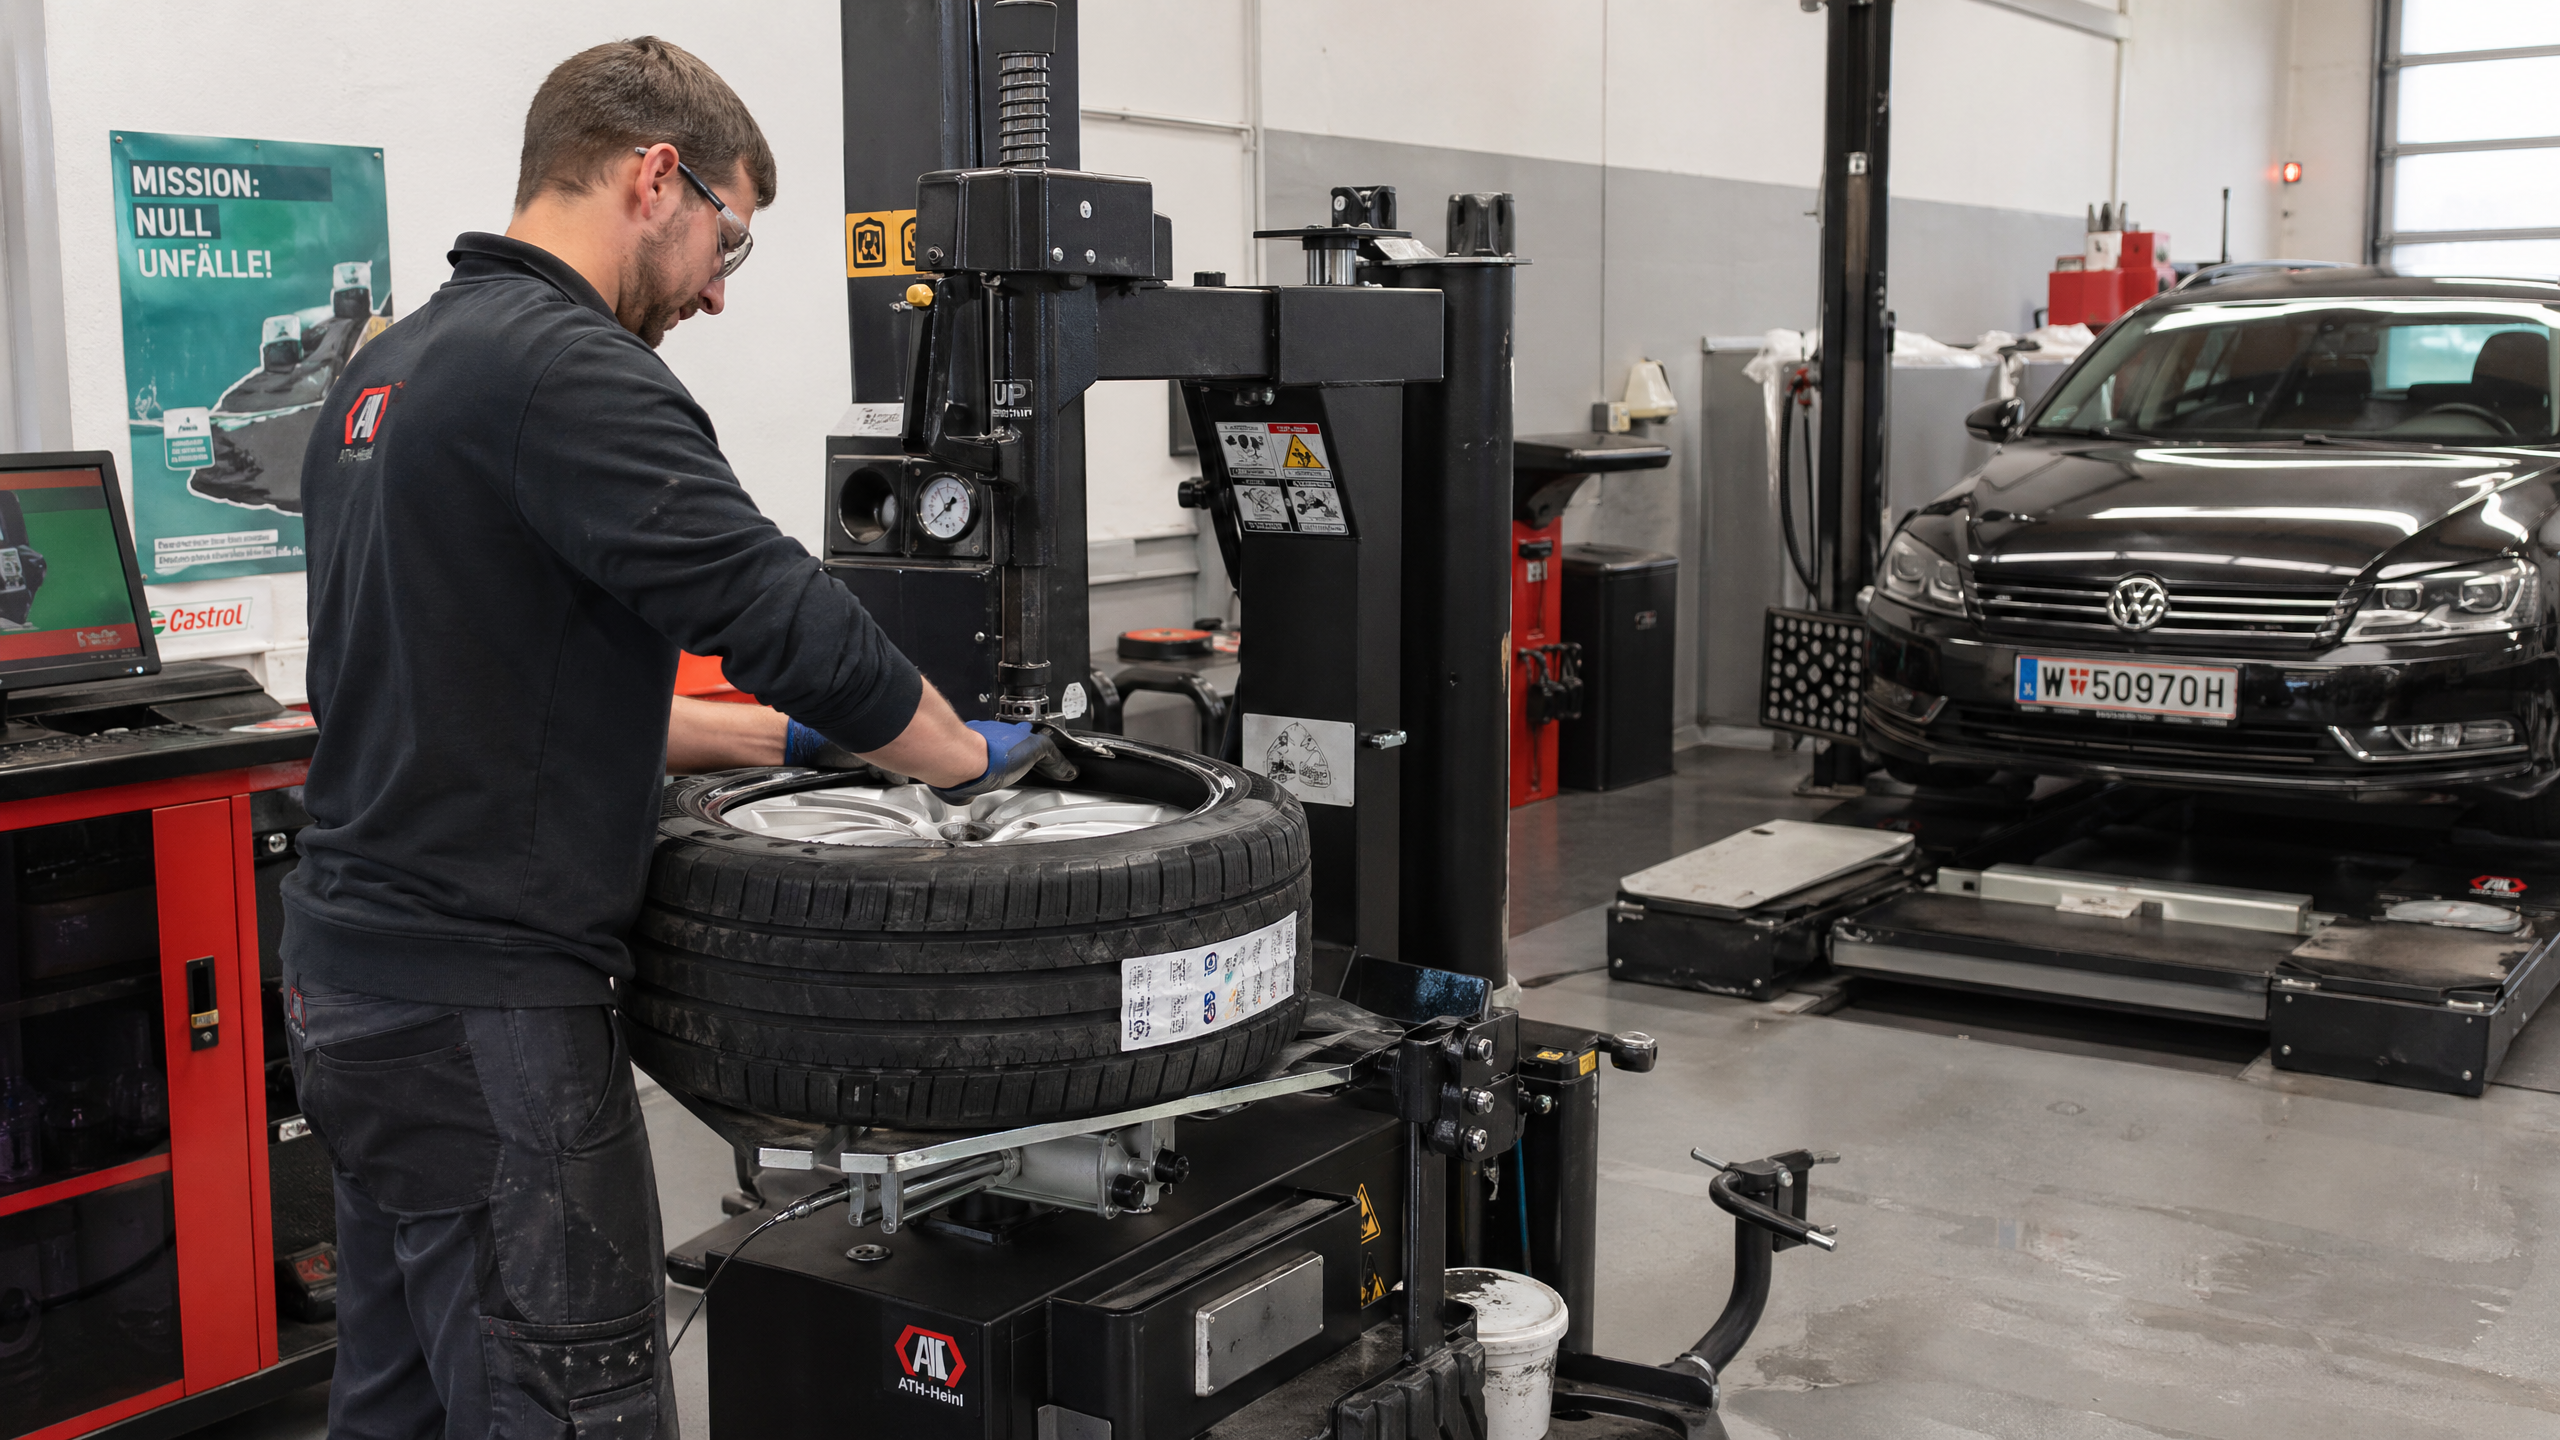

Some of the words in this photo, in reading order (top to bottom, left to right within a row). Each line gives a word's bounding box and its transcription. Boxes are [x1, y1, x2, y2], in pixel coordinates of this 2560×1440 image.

[132, 165, 260, 198] MISSION:
[135, 207, 212, 237] NULL
[137, 243, 273, 279] UNFÄLLE!
[994, 383, 1027, 406] UP
[169, 603, 243, 633] Castrol
[2042, 666, 2065, 697] W
[898, 1377, 964, 1407] ATH-Heinl
